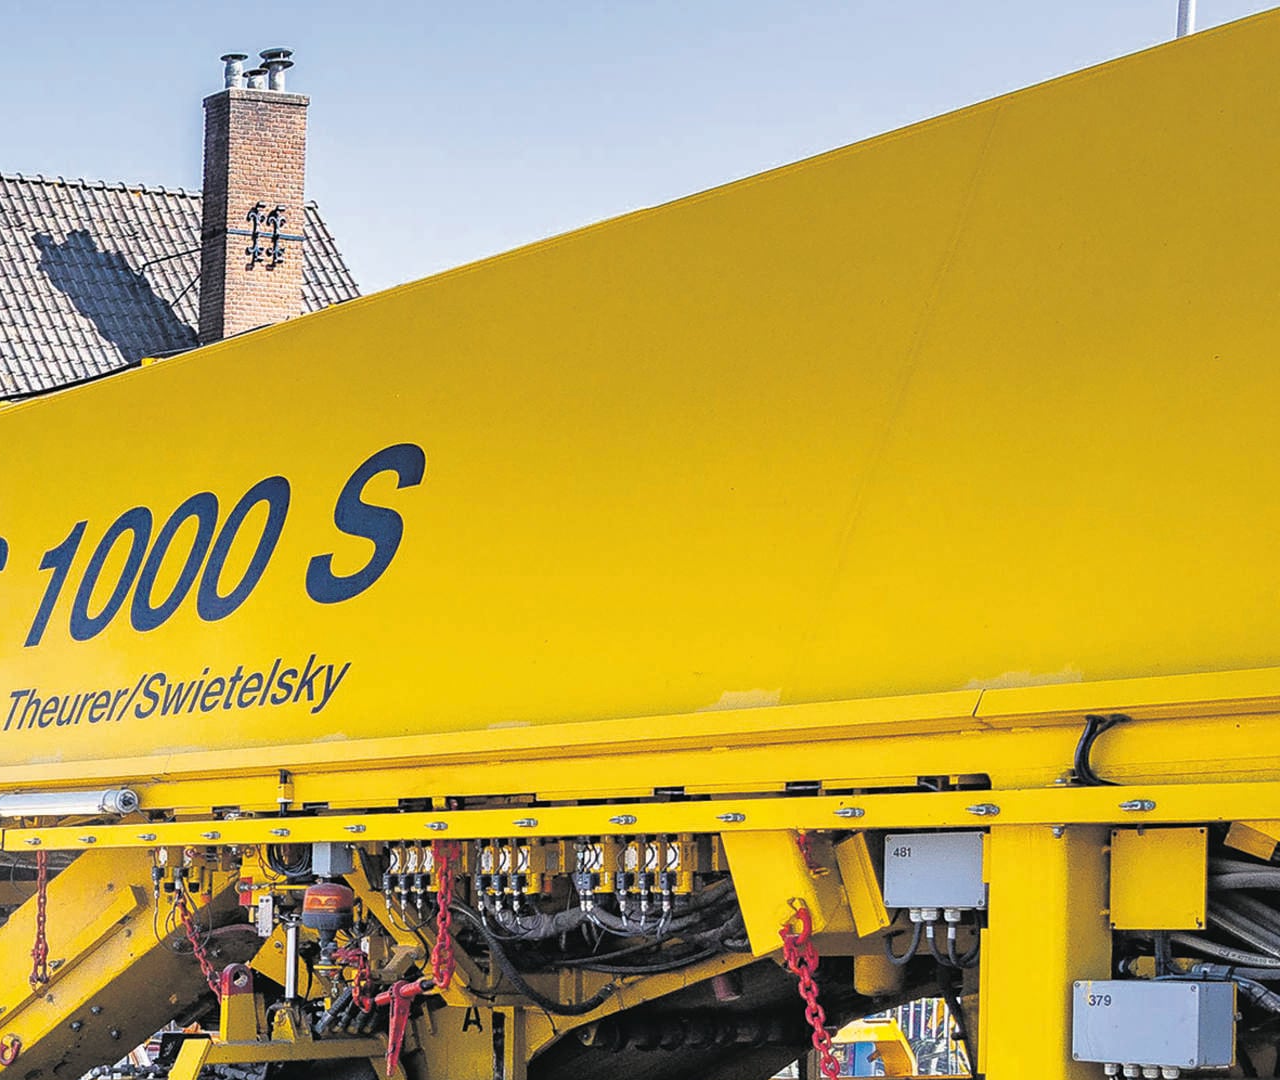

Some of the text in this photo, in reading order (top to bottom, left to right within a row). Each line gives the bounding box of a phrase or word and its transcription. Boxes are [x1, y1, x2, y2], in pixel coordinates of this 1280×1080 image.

[23, 474, 292, 649] 1000
[304, 442, 428, 605] S
[1, 653, 353, 733] Theurer/Swietelsky
[892, 847, 911, 858] 481
[1088, 994, 1112, 1007] 379
[462, 1006, 483, 1033] A
